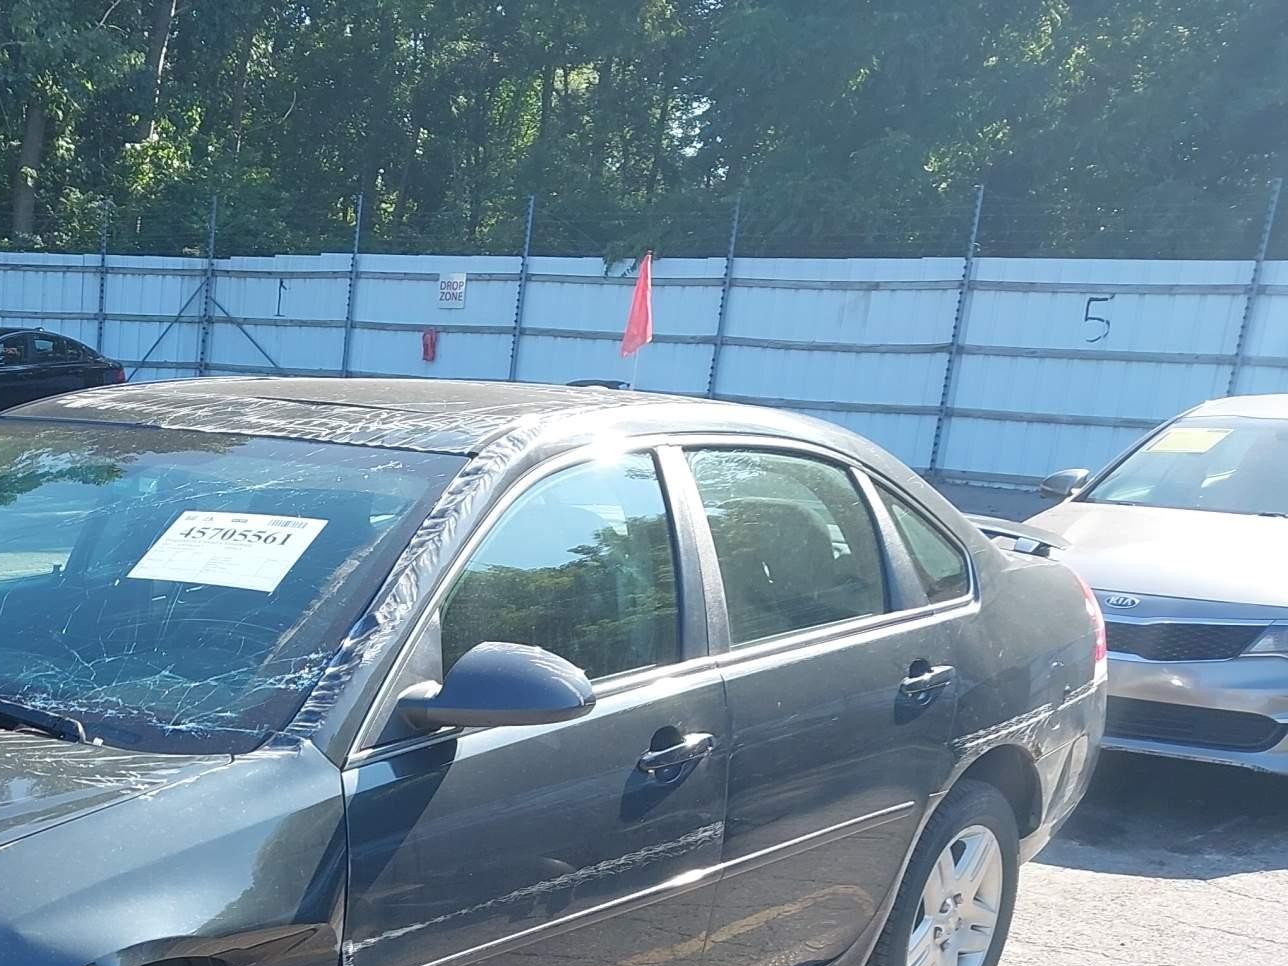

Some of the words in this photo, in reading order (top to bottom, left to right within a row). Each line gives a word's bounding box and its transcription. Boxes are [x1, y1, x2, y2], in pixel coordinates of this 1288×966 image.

[439, 280, 464, 291] DROP
[439, 291, 463, 302] ZONE
[1084, 293, 1116, 343] 5
[179, 526, 293, 546] 45705561
[1109, 596, 1132, 606] KIA
